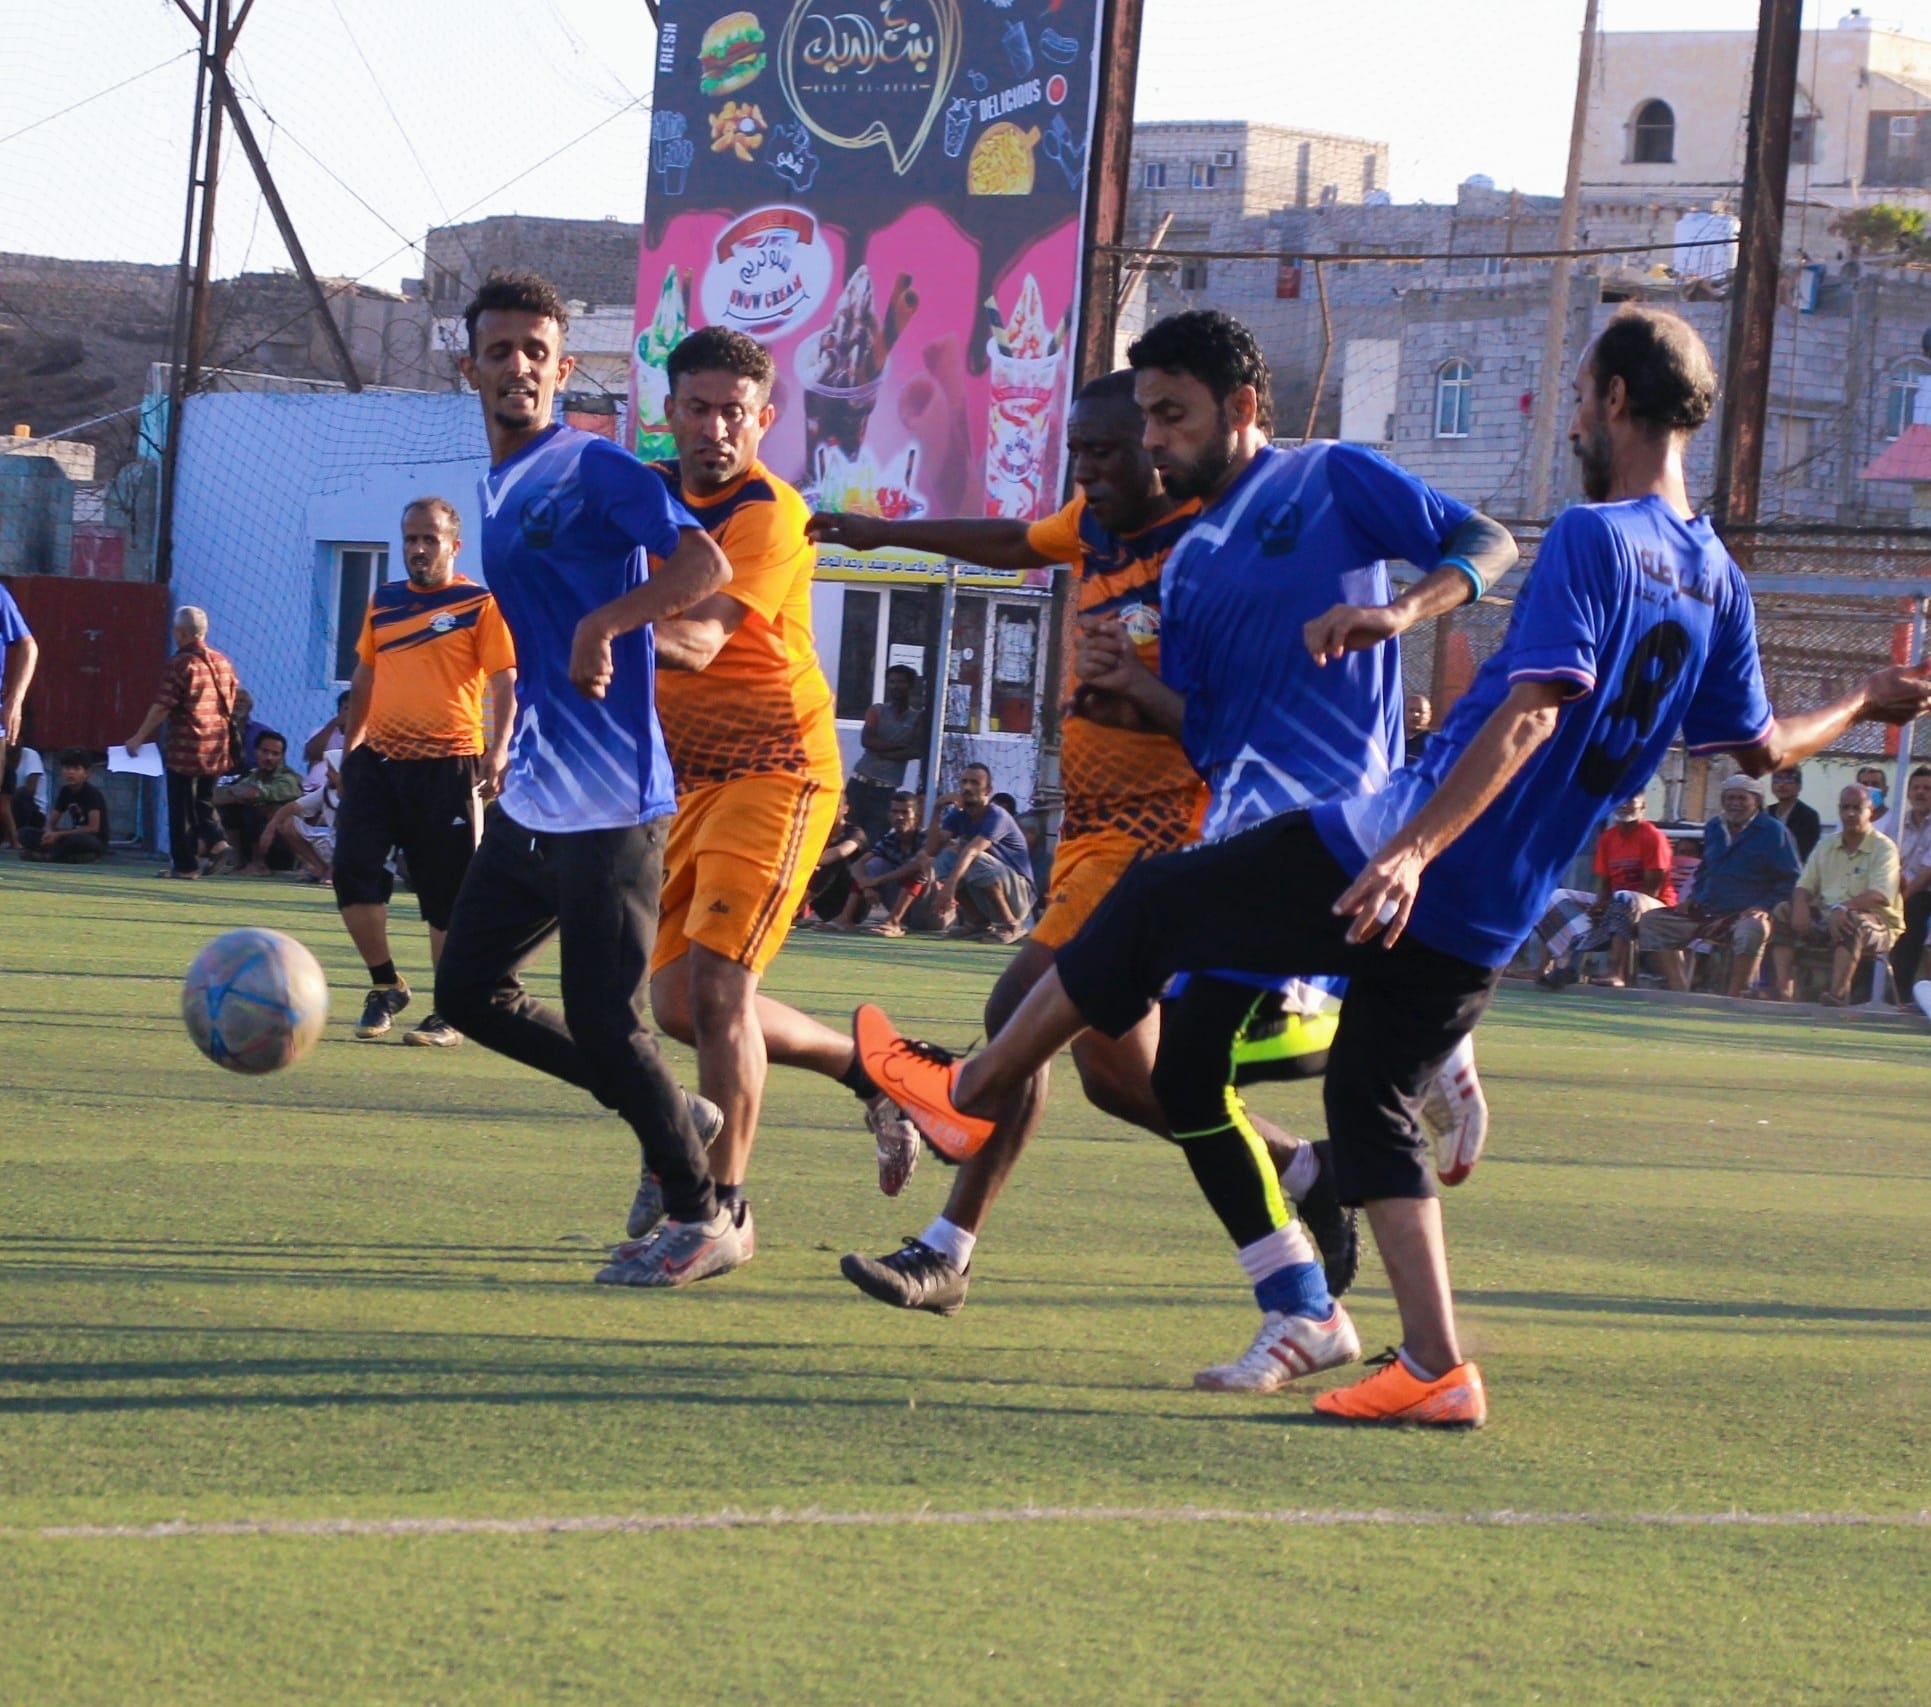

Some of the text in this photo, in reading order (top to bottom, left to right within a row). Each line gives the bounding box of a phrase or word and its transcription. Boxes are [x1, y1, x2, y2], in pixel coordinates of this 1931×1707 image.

[659, 22, 678, 72] FRESH
[979, 78, 1042, 122] DELICIOUS
[730, 273, 803, 310] SNOW CREAM
